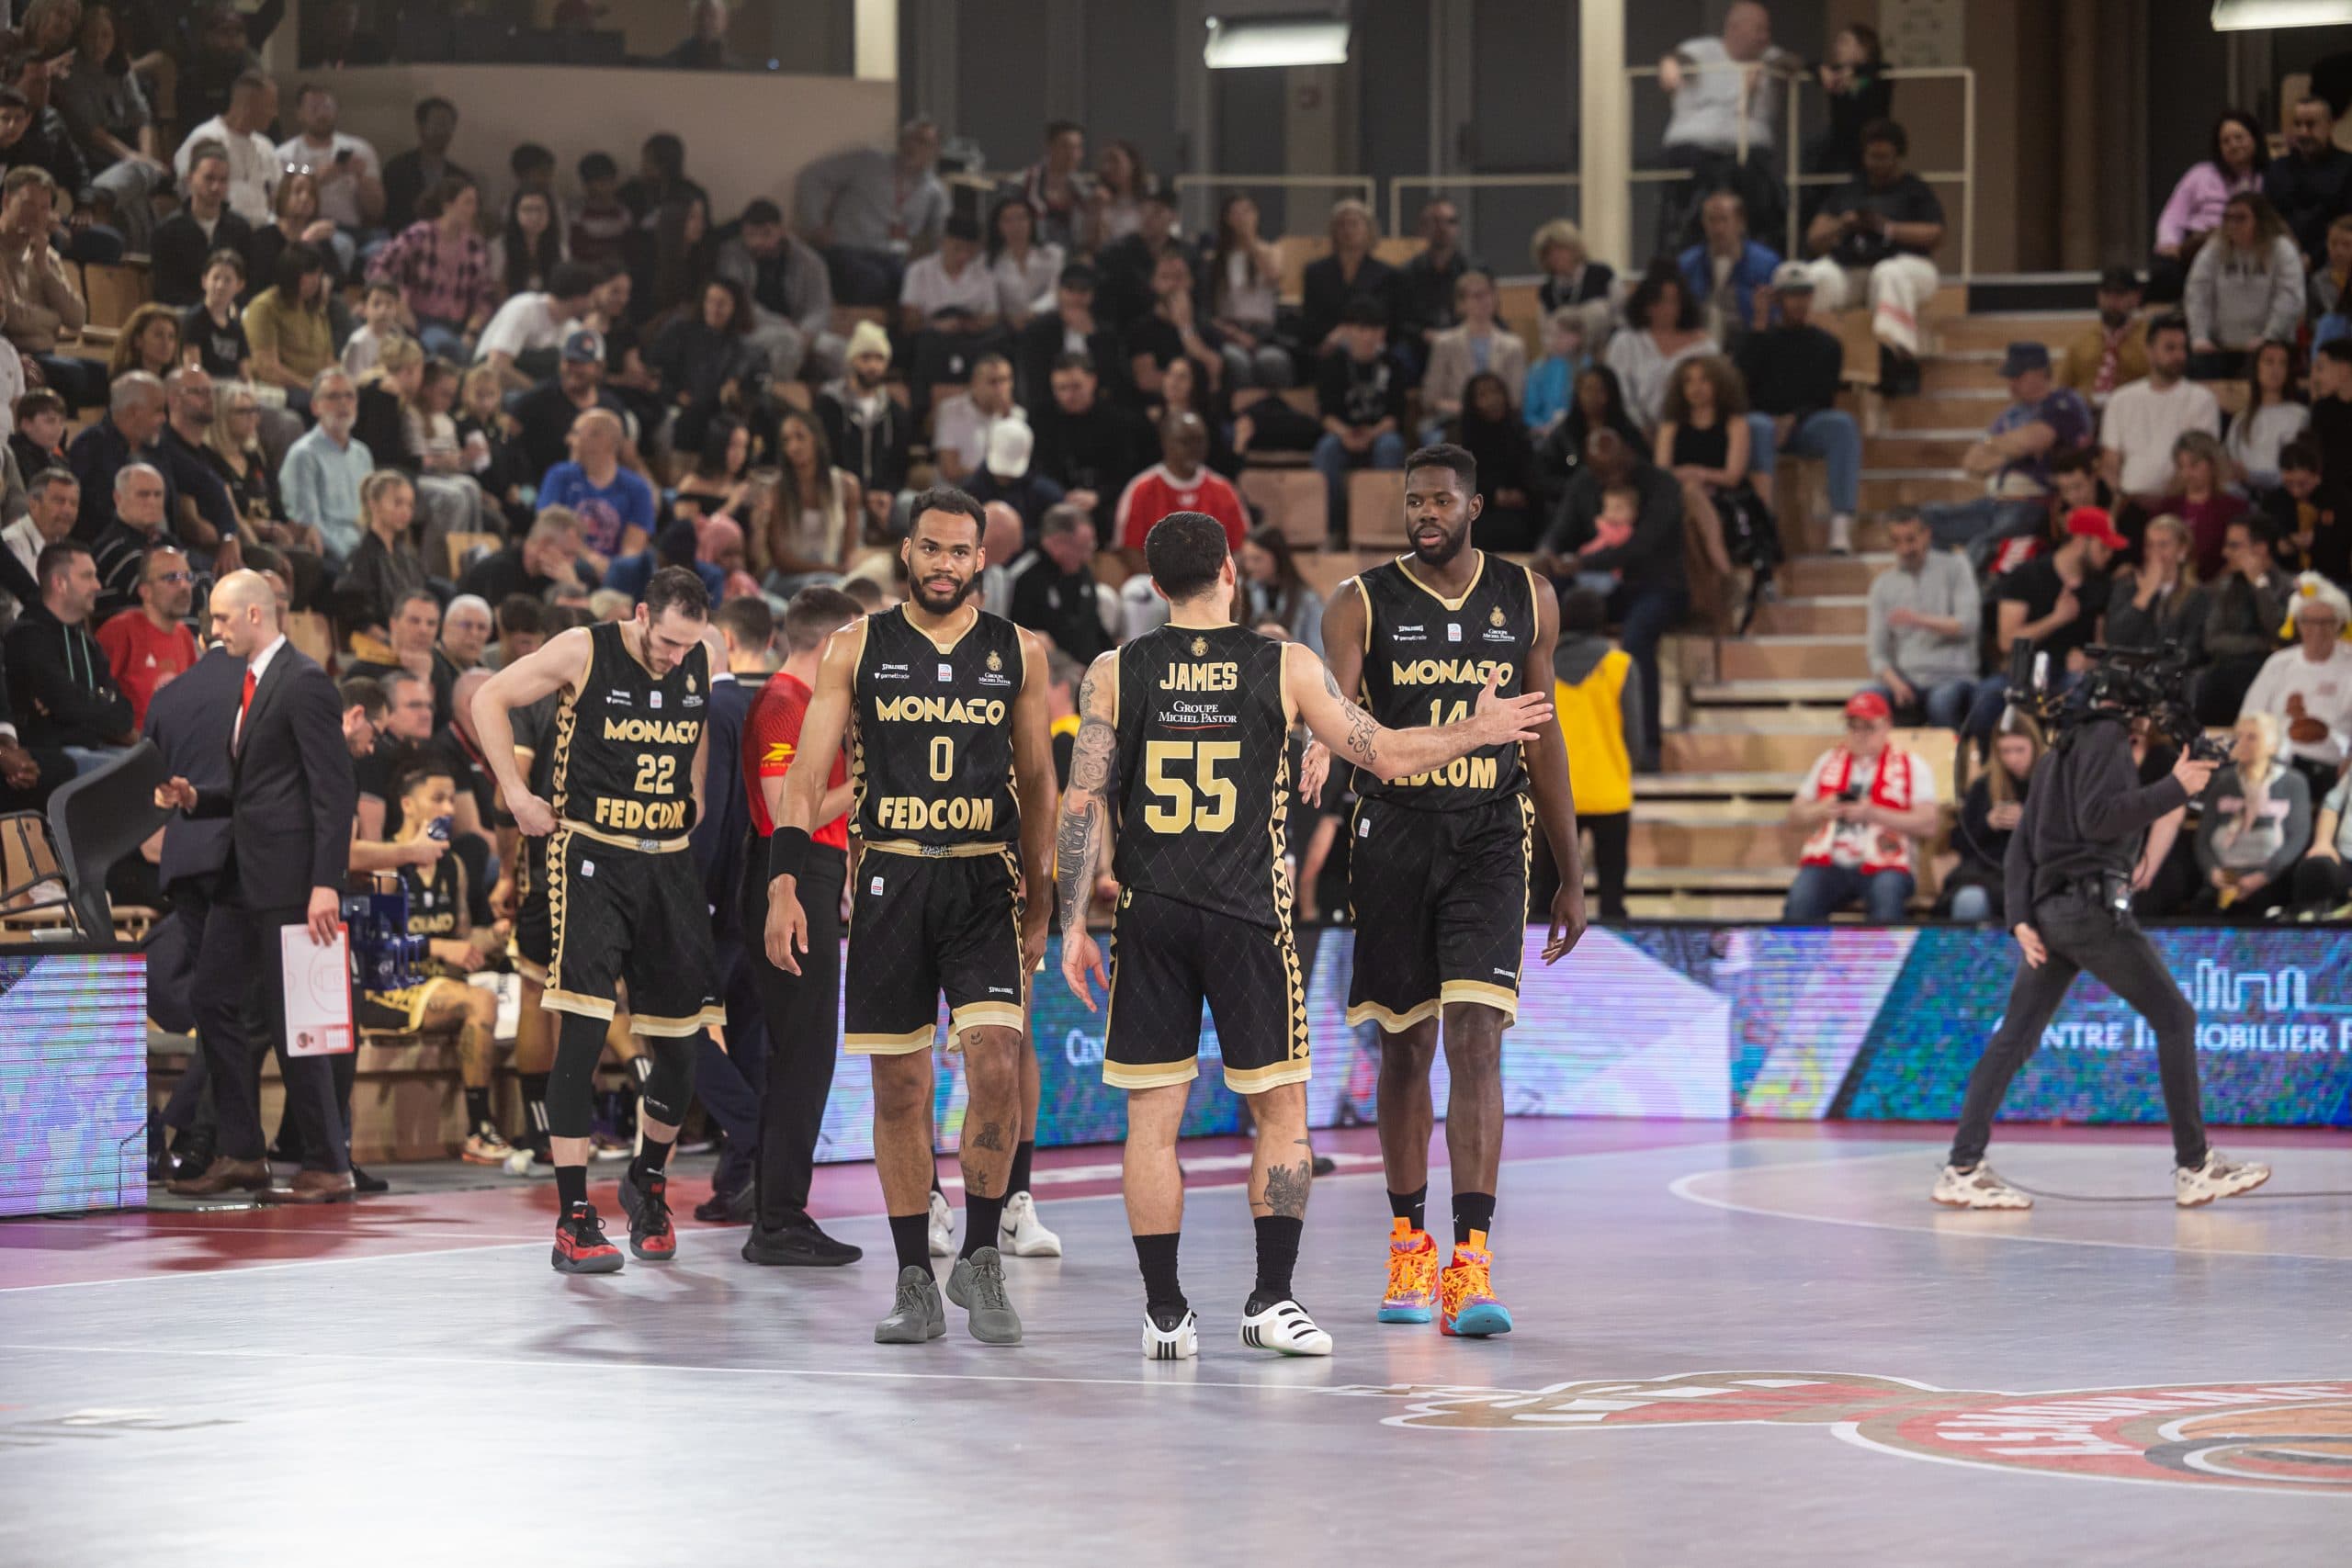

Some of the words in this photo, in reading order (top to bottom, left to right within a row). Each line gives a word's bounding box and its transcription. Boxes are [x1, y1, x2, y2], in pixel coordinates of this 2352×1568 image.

[1159, 661, 1238, 692] JAMES
[1392, 659, 1513, 687] MONACO
[875, 695, 1006, 726] MONACO
[1158, 711, 1199, 724] MICHEL
[1201, 713, 1238, 724] PASTOR
[1172, 700, 1219, 713] GROUPE
[603, 716, 699, 744] MONACO
[634, 753, 676, 795] 22
[929, 736, 955, 782] 0
[1144, 740, 1241, 834] 55
[594, 796, 685, 831] FEDCOM
[877, 795, 993, 831] FEDCOM
[2133, 1017, 2329, 1053] IOBILIER
